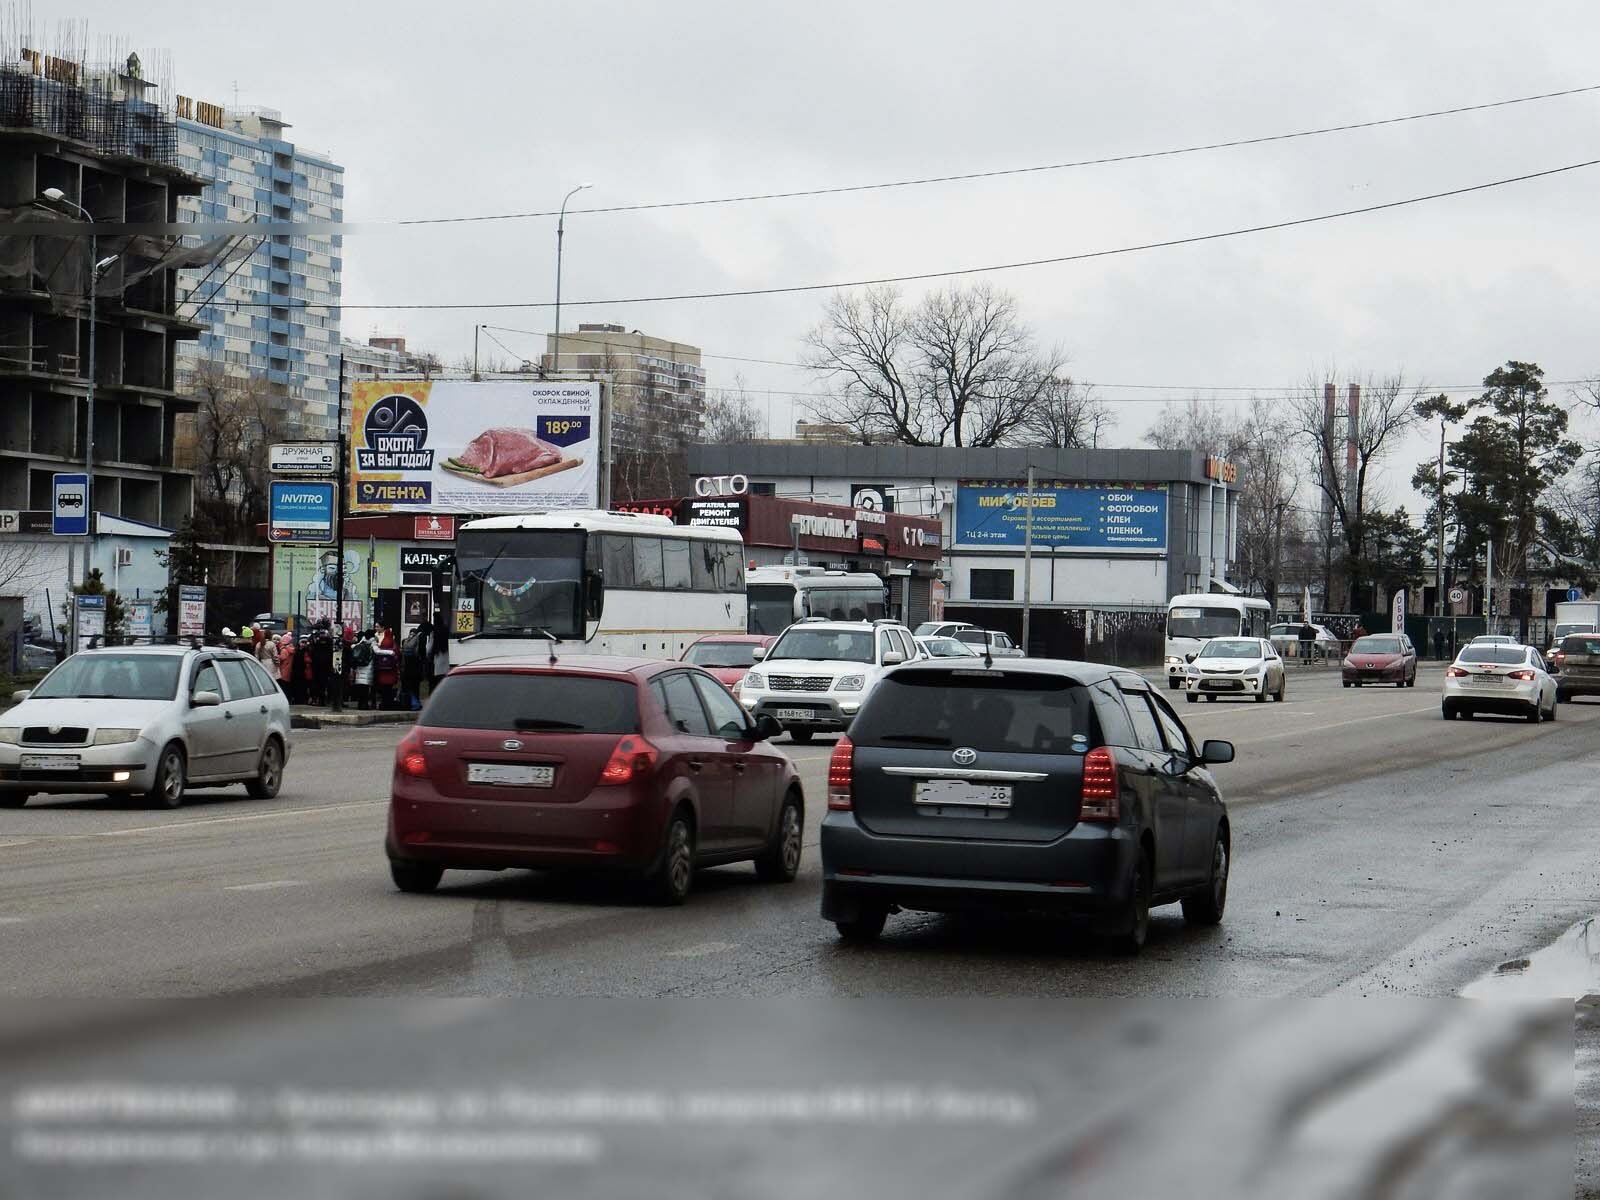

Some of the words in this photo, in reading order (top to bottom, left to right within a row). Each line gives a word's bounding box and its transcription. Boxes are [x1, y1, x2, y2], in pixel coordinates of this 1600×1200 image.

[561, 389, 592, 398] СВИНОЙ,
[377, 437, 415, 452] ОХОТА
[281, 447, 323, 456] ДРУЖНАЯ
[360, 453, 376, 467] ЗА
[377, 450, 431, 468] ВЫГОДОЙ
[695, 474, 748, 496] СТО
[375, 486, 427, 499] ЛЕНТА
[281, 493, 323, 504] INVITRO
[979, 496, 1005, 508] МИР
[1107, 494, 1133, 502] ОБОИ
[699, 509, 731, 517] РЕМОНТ
[1107, 504, 1159, 513] ФОТООБОИ
[690, 516, 740, 527] ДВИГАТЕЛЕЙ
[1002, 515, 1036, 523] Огромнй
[1107, 515, 1131, 524] КЛЕИ
[966, 530, 976, 539] ТЦ
[1107, 526, 1143, 535] ПЛЕНКИ
[903, 526, 924, 547] СТО
[1451, 592, 1461, 600] 40
[461, 600, 472, 610] 66
